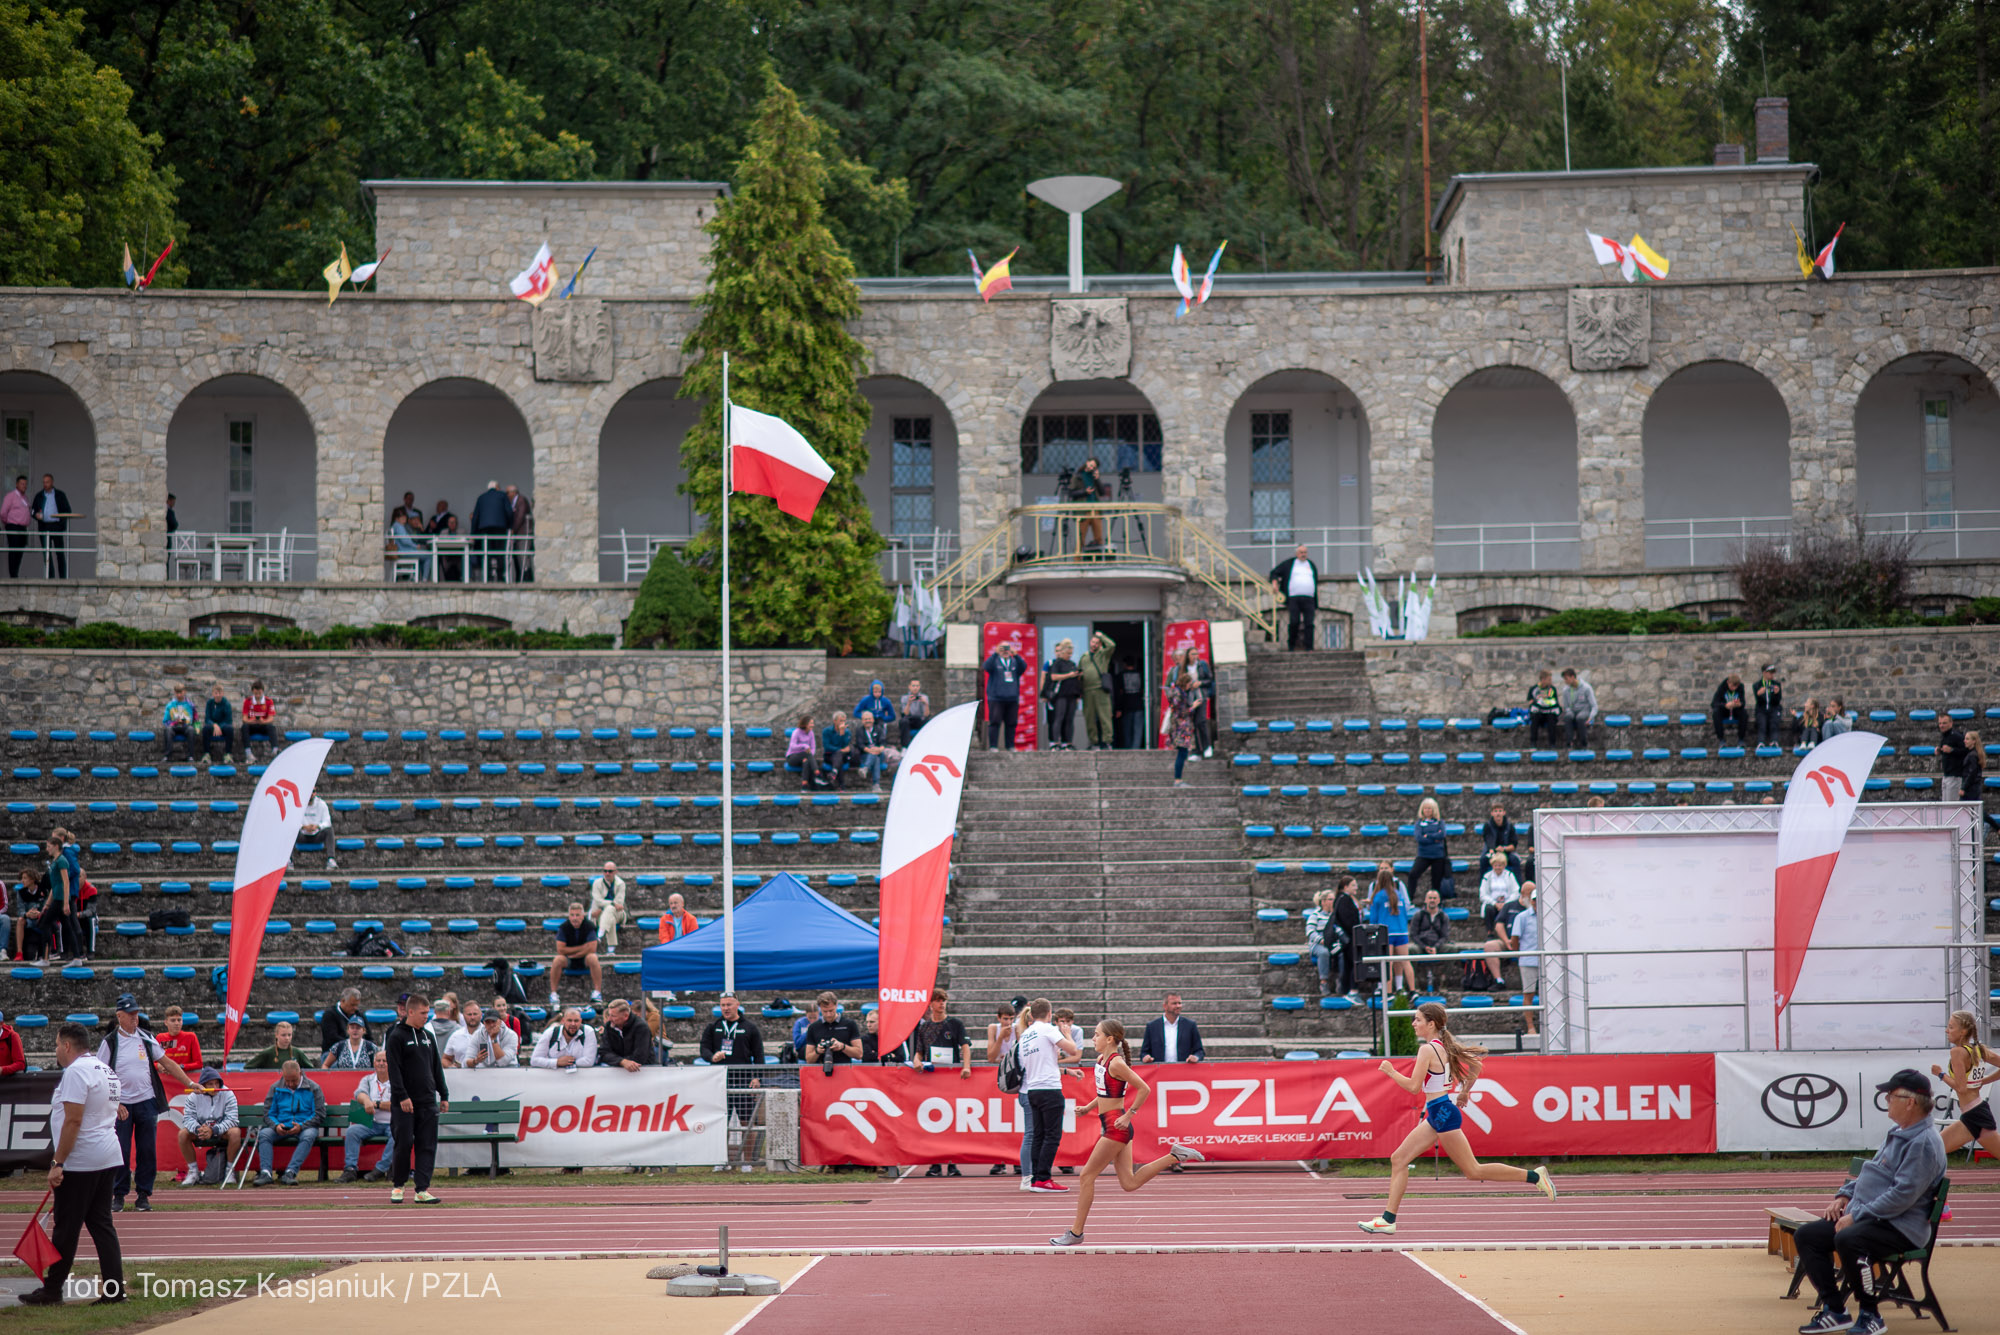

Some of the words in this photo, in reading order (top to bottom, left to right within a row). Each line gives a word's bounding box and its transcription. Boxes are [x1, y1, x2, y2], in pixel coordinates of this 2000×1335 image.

[880, 988, 927, 1002] ORLEN
[1972, 1066, 1985, 1080] 852
[1157, 1077, 1372, 1128] PZLA
[1532, 1085, 1691, 1123] ORLEN
[516, 1094, 694, 1144] polanik
[1158, 1136, 1203, 1146] POLSKI
[1265, 1132, 1314, 1143] LEKKIEJ
[1317, 1131, 1373, 1142] ATLETYKI
